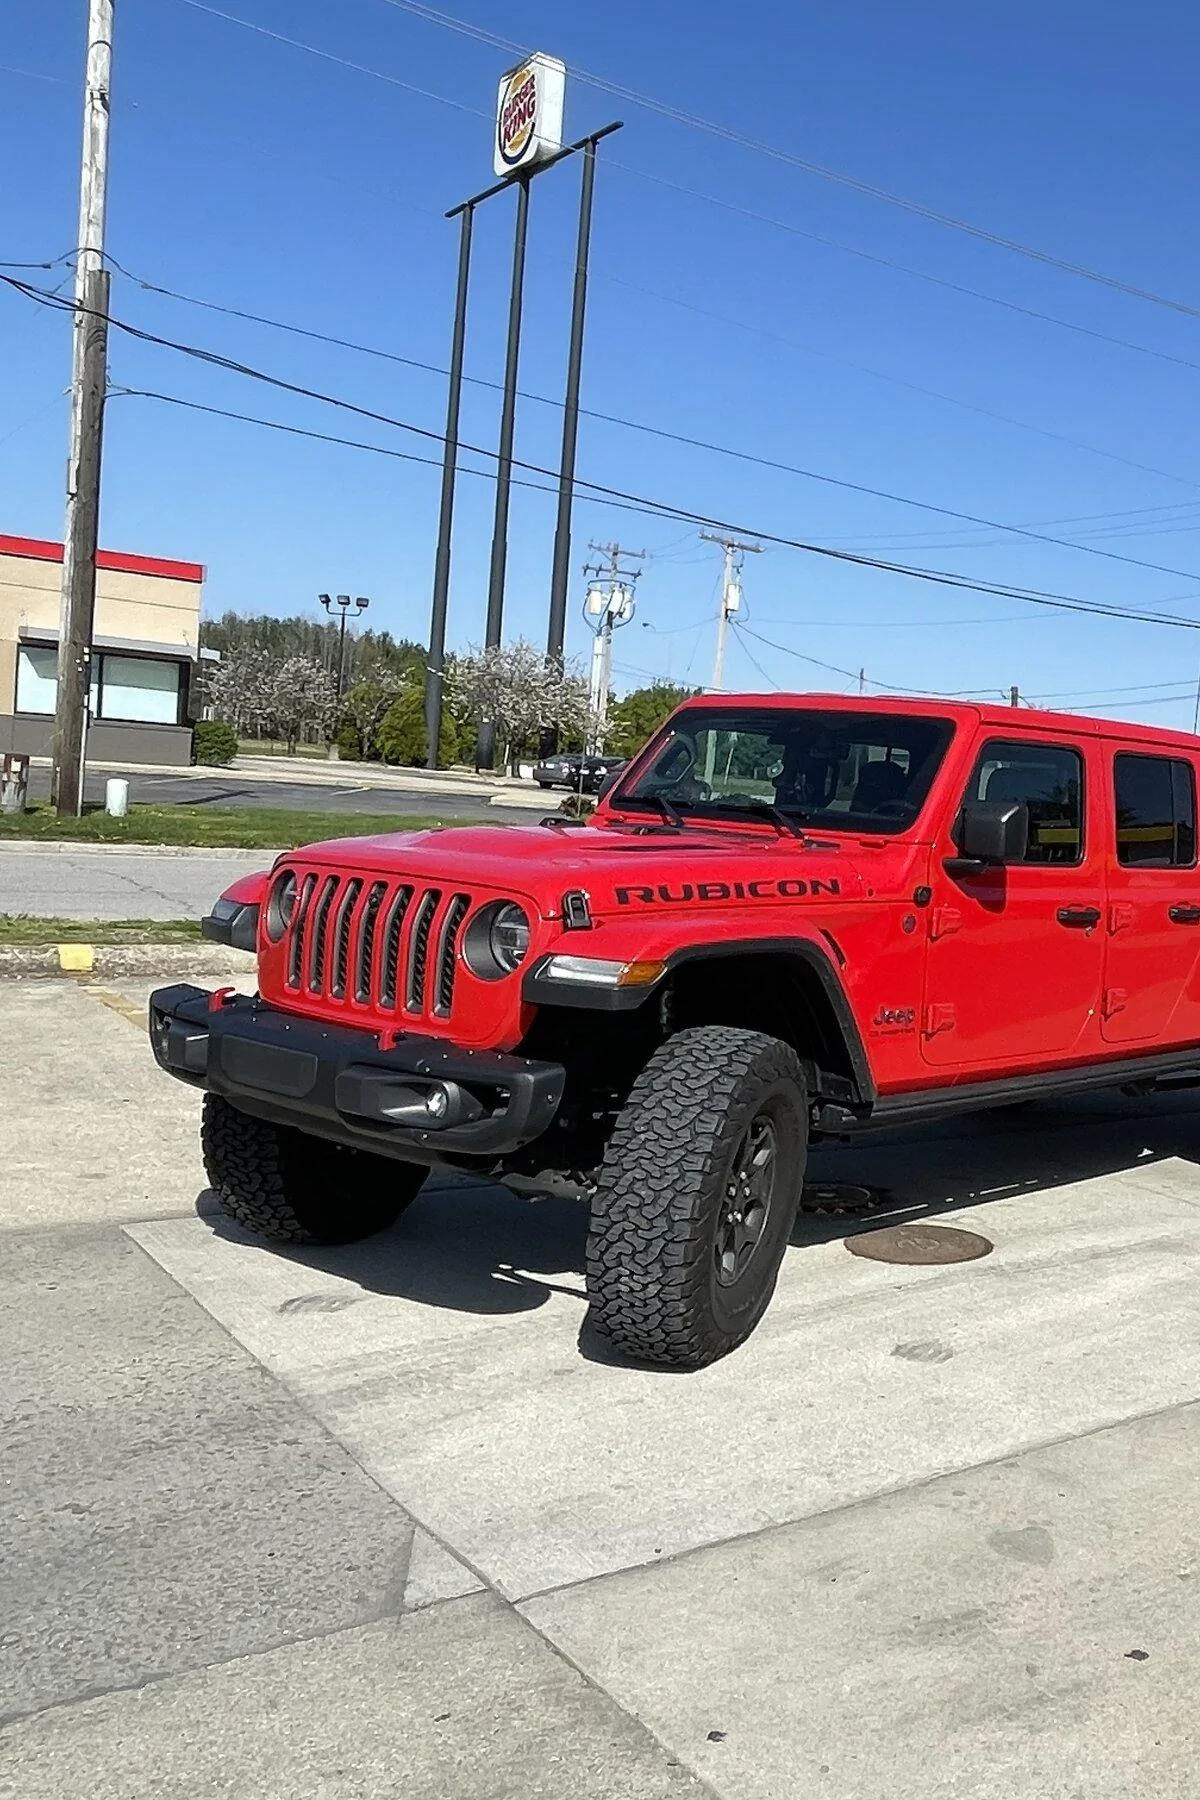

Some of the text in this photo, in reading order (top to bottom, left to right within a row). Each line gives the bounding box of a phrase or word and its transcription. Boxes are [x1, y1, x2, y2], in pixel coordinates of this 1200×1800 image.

[503, 74, 536, 127] BURGER
[504, 91, 536, 151] KING
[614, 878, 841, 905] RUBICON
[872, 1005, 916, 1027] Jeep
